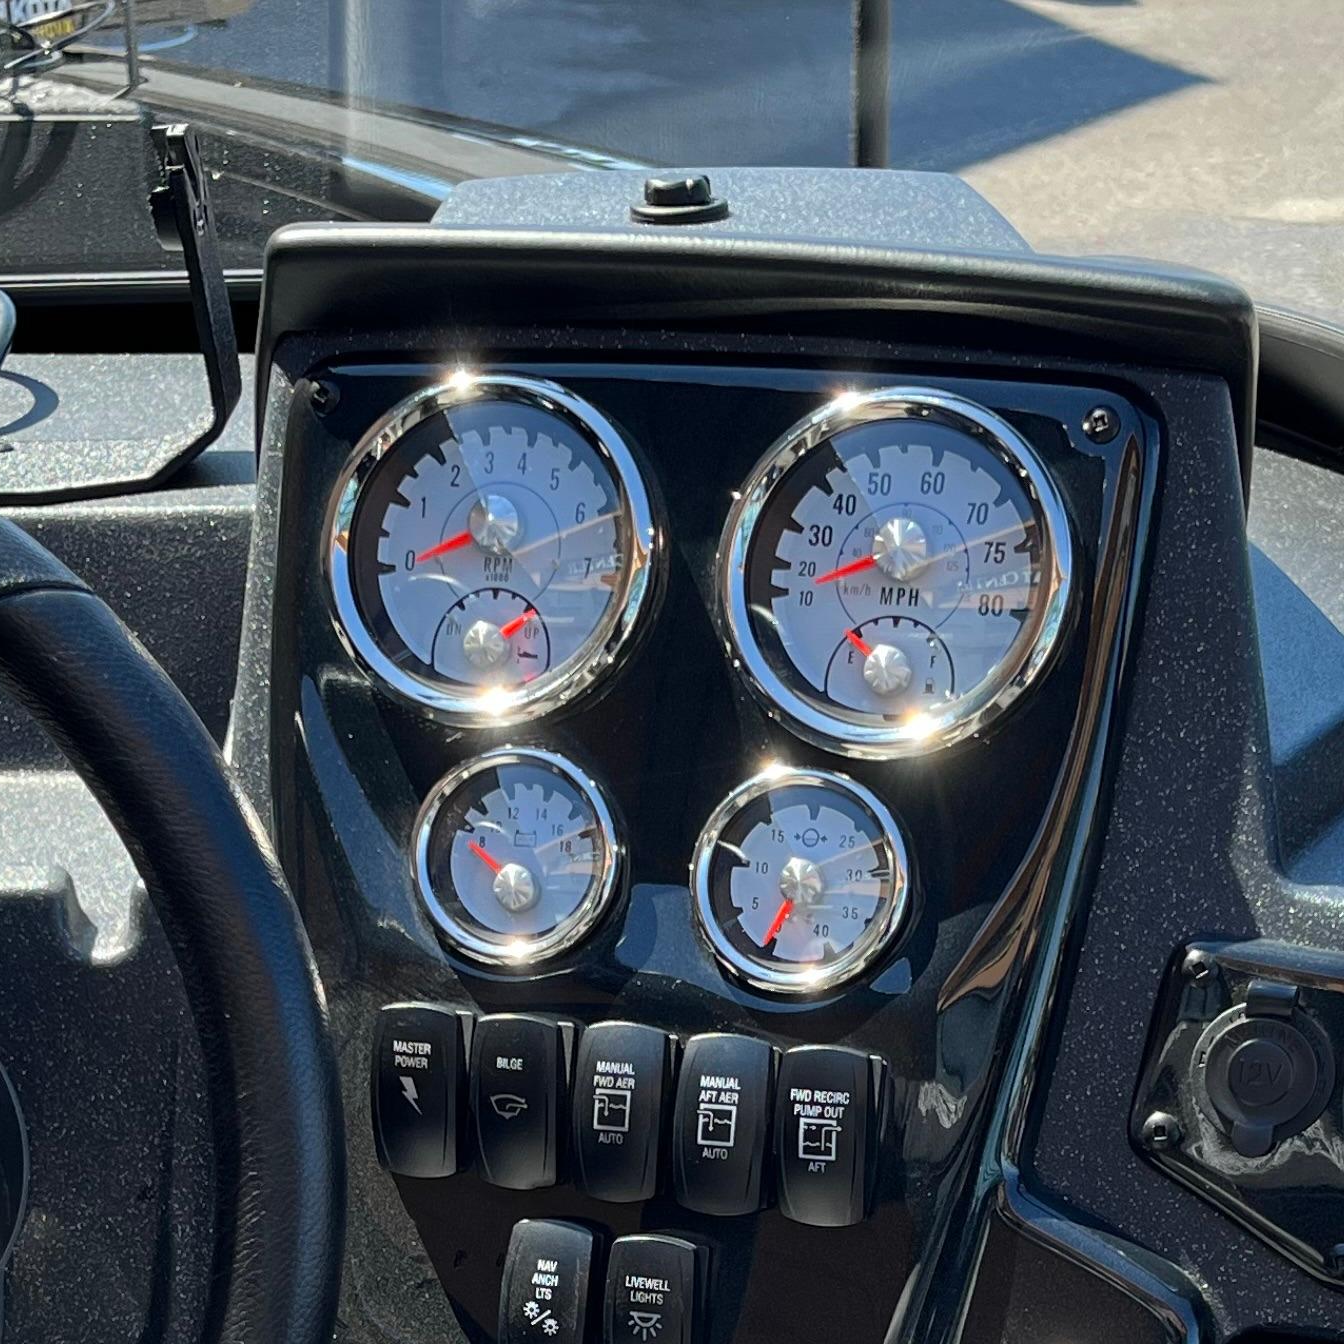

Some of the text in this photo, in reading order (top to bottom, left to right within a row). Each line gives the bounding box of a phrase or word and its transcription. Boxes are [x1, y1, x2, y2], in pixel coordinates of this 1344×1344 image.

[484, 453, 495, 475] 3
[517, 453, 528, 476] 4
[450, 465, 461, 488] 2
[550, 468, 560, 490] 5
[920, 472, 946, 495] 60
[867, 473, 892, 497] 50
[420, 497, 427, 519] 1
[833, 493, 857, 516] 40
[575, 502, 585, 525] 6
[966, 502, 989, 526] 70
[808, 526, 833, 547] 30
[983, 541, 1006, 564] 75
[405, 551, 416, 572] 0
[484, 557, 514, 574] RPM
[583, 558, 593, 579] 7
[799, 562, 816, 578] 20
[799, 590, 813, 607] 10
[879, 587, 920, 608] MPH
[978, 593, 1004, 617] 80
[524, 627, 540, 640] UP
[847, 650, 854, 665] E
[930, 655, 937, 669] F
[507, 807, 519, 820] 12
[536, 808, 548, 821] 14
[551, 824, 564, 837] 16
[771, 830, 785, 843] 15
[478, 836, 486, 849] 8
[559, 840, 572, 853] 18
[839, 835, 856, 849] 25
[755, 861, 769, 875] 10
[845, 869, 863, 883] 30
[752, 897, 760, 911] 5
[842, 906, 858, 920] 35
[812, 924, 829, 938] 40
[393, 1040, 431, 1055] MASTER
[394, 1055, 429, 1069] POWER
[496, 1056, 523, 1071] BILGE
[596, 1060, 635, 1075] MANUAL
[1238, 1055, 1285, 1089] 12V
[593, 1075, 635, 1089] FWD AER
[700, 1075, 741, 1090] MANUAL
[698, 1090, 739, 1105] AFT AER
[790, 1088, 850, 1105] FWD RECIRC
[793, 1104, 845, 1119] PUMP OUT
[598, 1132, 624, 1145] AUTO
[702, 1147, 728, 1160] AUTO
[808, 1161, 826, 1174] AFT
[537, 1259, 558, 1272] NAV
[531, 1273, 558, 1287] ANCH
[625, 1275, 671, 1292] LIVEWELL
[535, 1287, 552, 1300] LTS
[630, 1291, 664, 1305] LIGHTS
